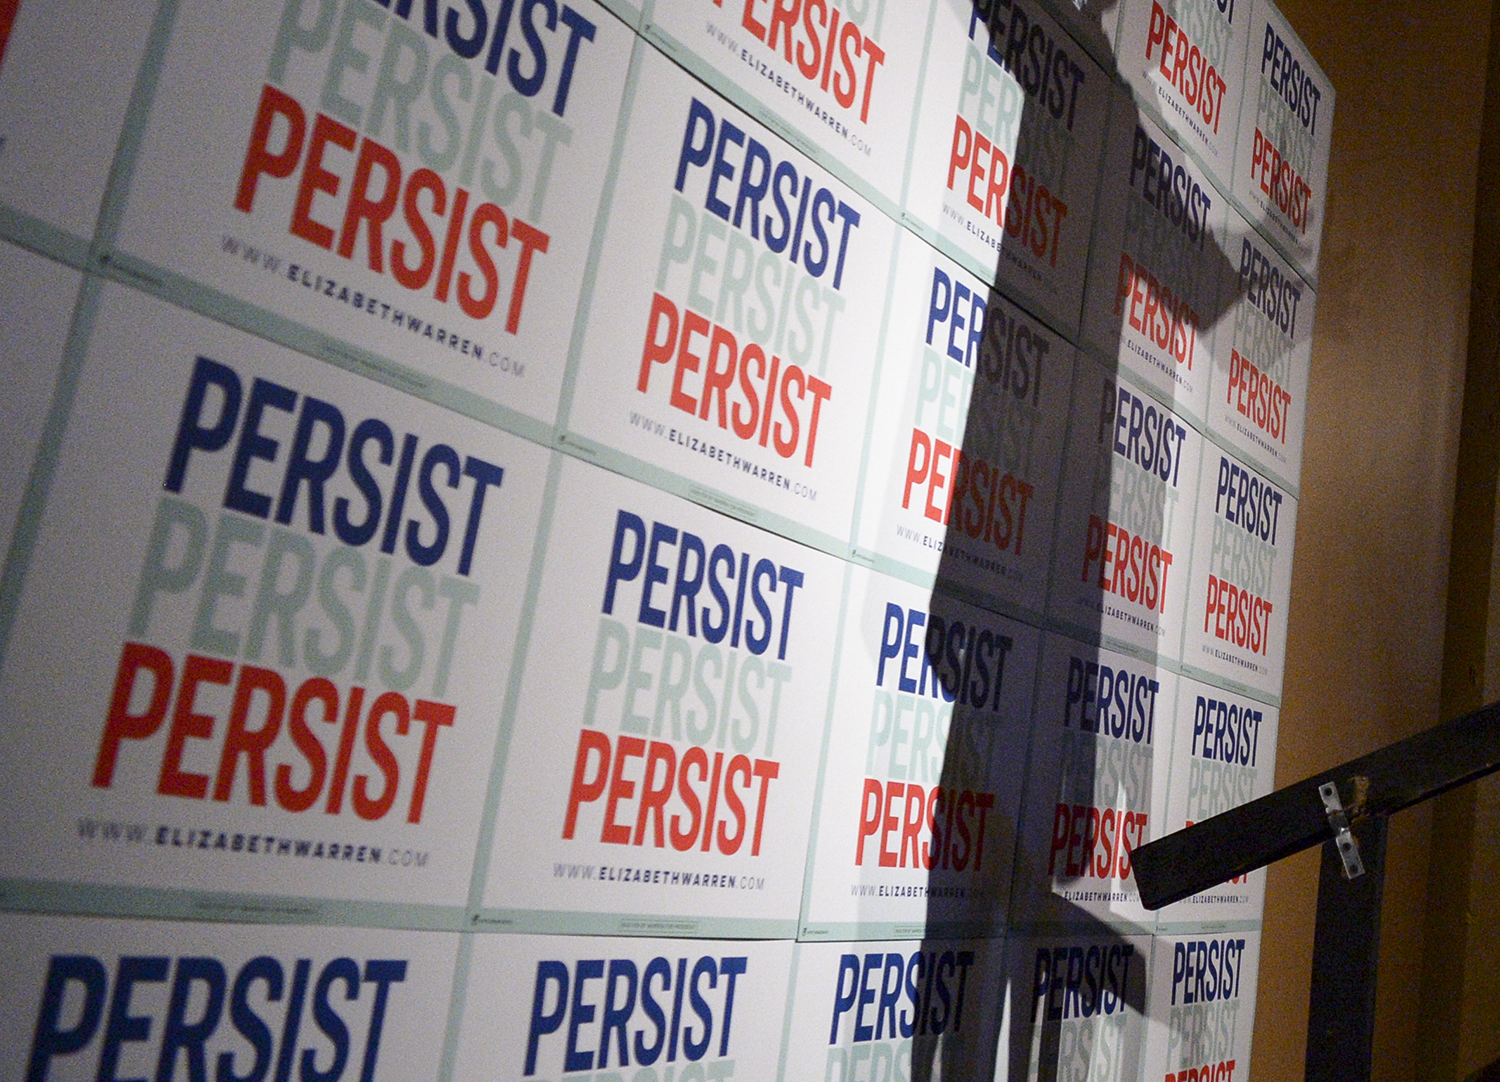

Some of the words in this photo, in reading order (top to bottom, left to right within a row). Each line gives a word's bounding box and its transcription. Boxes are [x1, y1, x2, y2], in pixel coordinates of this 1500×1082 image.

[1145, 1, 1226, 135] PERSIST
[1263, 22, 1321, 132] PERSIST
[234, 85, 550, 335] PERSIST
[675, 97, 860, 290] PERSIST
[947, 115, 1067, 268] PERSIST
[1129, 125, 1211, 254] PERSIST
[1251, 125, 1312, 232] PERSIST
[656, 195, 846, 378] PERSIST
[925, 266, 1050, 409] PERSIST
[1115, 252, 1199, 375] PERSIST
[1239, 238, 1300, 338] PERSIST
[637, 294, 832, 467] PERSIST
[1098, 377, 1186, 488] PERSIST
[1227, 348, 1291, 447] PERSIST
[165, 356, 504, 576] PERSIST
[902, 428, 1033, 555] PERSIST
[1216, 456, 1282, 545] PERSIST
[129, 496, 480, 699] PERSIST
[601, 509, 804, 660] PERSIST
[1083, 515, 1172, 611] PERSIST
[1205, 575, 1272, 654] PERSIST
[1210, 516, 1277, 600] PERSIST
[582, 616, 792, 757] PERSIST
[877, 602, 1012, 712] PERSIST
[1064, 656, 1159, 744] PERSIST
[91, 641, 456, 824] PERSIST
[1191, 695, 1262, 764] PERSIST
[562, 727, 779, 857] PERSIST
[855, 778, 995, 870] PERSIST
[23, 954, 408, 1082] PERSIST
[523, 955, 748, 1076] PERSIST
[829, 951, 975, 1043] PERSIST
[1030, 944, 1134, 1023] PERSIST
[1171, 939, 1245, 1008] PERSIST
[1166, 1000, 1240, 1075] PERSIST
